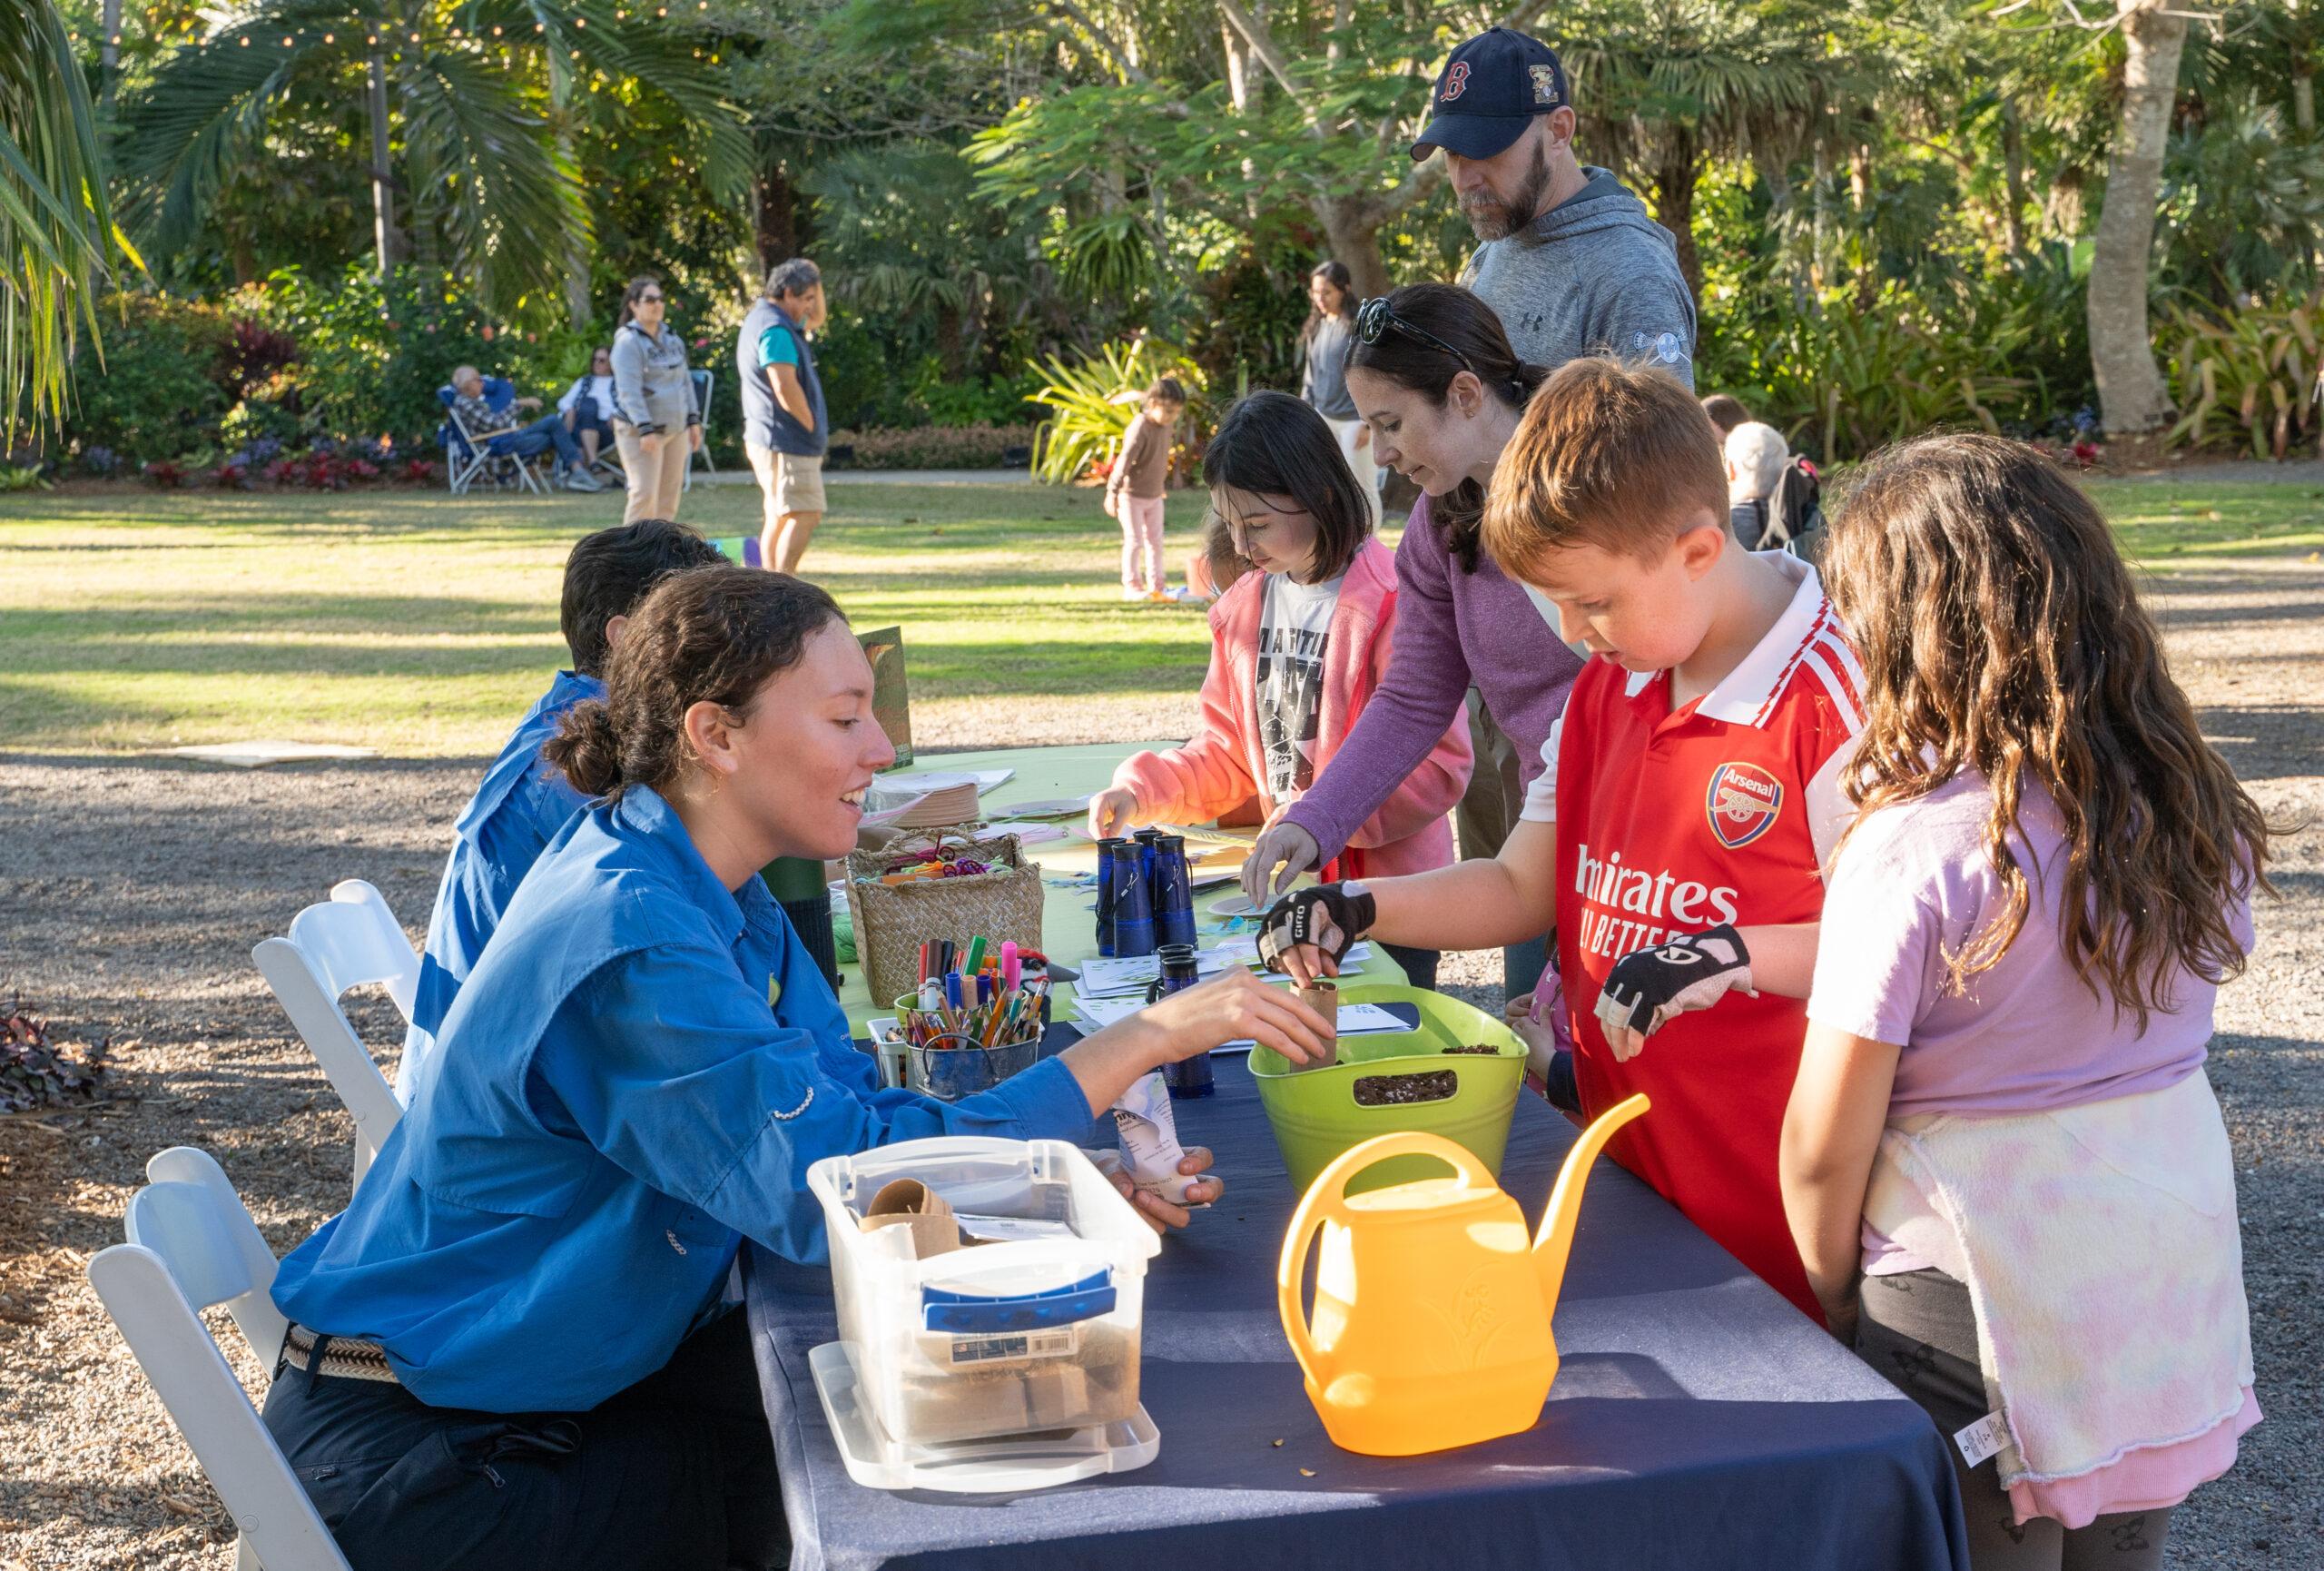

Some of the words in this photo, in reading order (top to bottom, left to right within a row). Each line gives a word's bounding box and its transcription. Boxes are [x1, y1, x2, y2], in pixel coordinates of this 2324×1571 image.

[1440, 61, 1472, 102] B
[1724, 768, 1774, 797] Arsenal
[1295, 905, 1305, 938] GIRO
